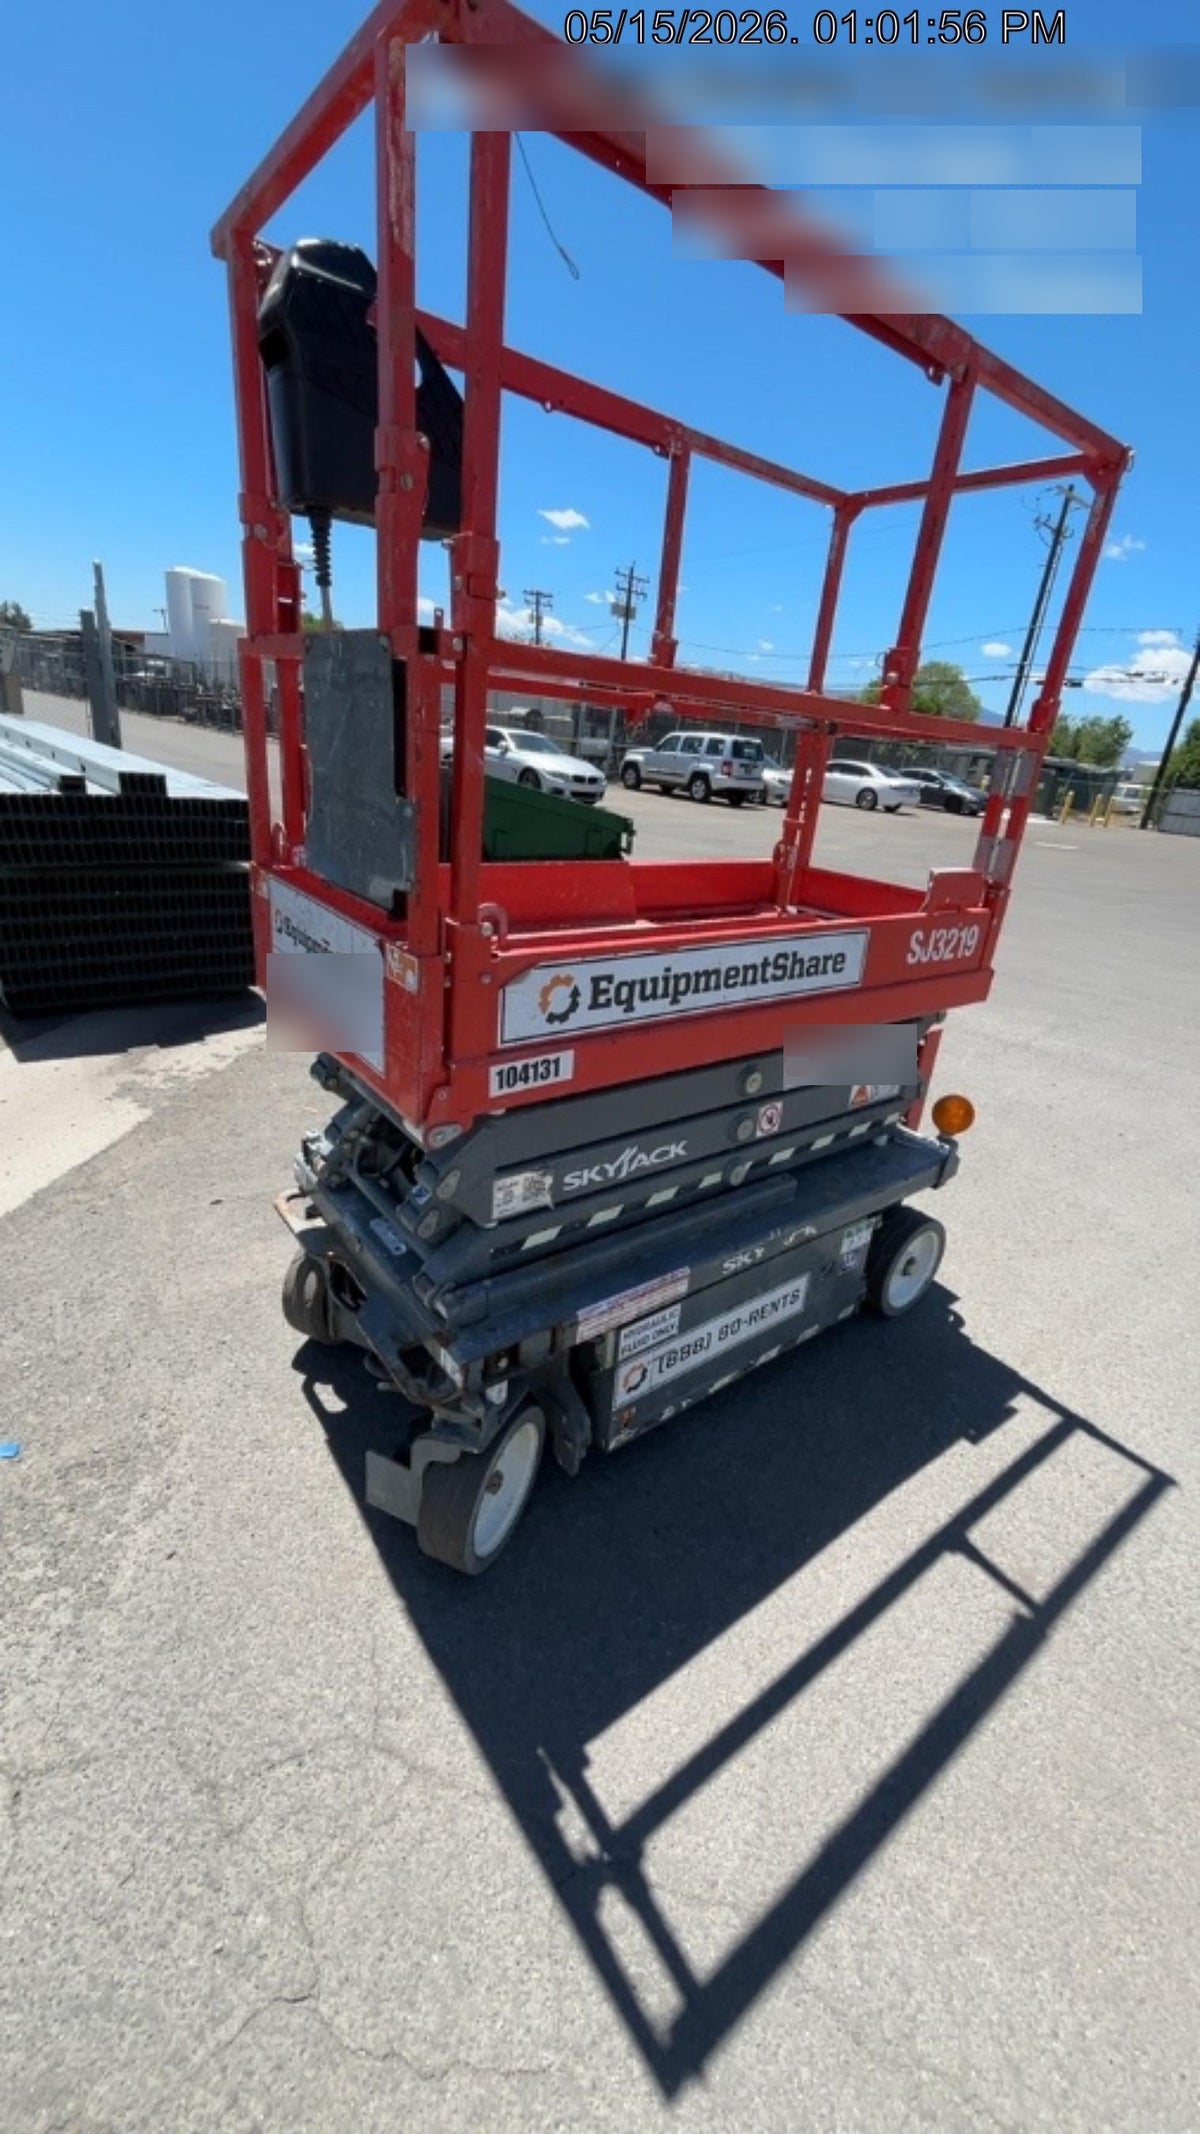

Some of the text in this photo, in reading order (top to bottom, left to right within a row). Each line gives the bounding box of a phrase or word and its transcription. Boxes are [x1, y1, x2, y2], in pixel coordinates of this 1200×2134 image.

[907, 925, 979, 964] SJ3219
[588, 951, 846, 1014] EquipmentShare
[496, 1057, 560, 1091] 104131
[563, 1140, 688, 1191] SKYJACK
[718, 1289, 801, 1342] 80-RENTS
[620, 1323, 677, 1357] FLUID ONLY
